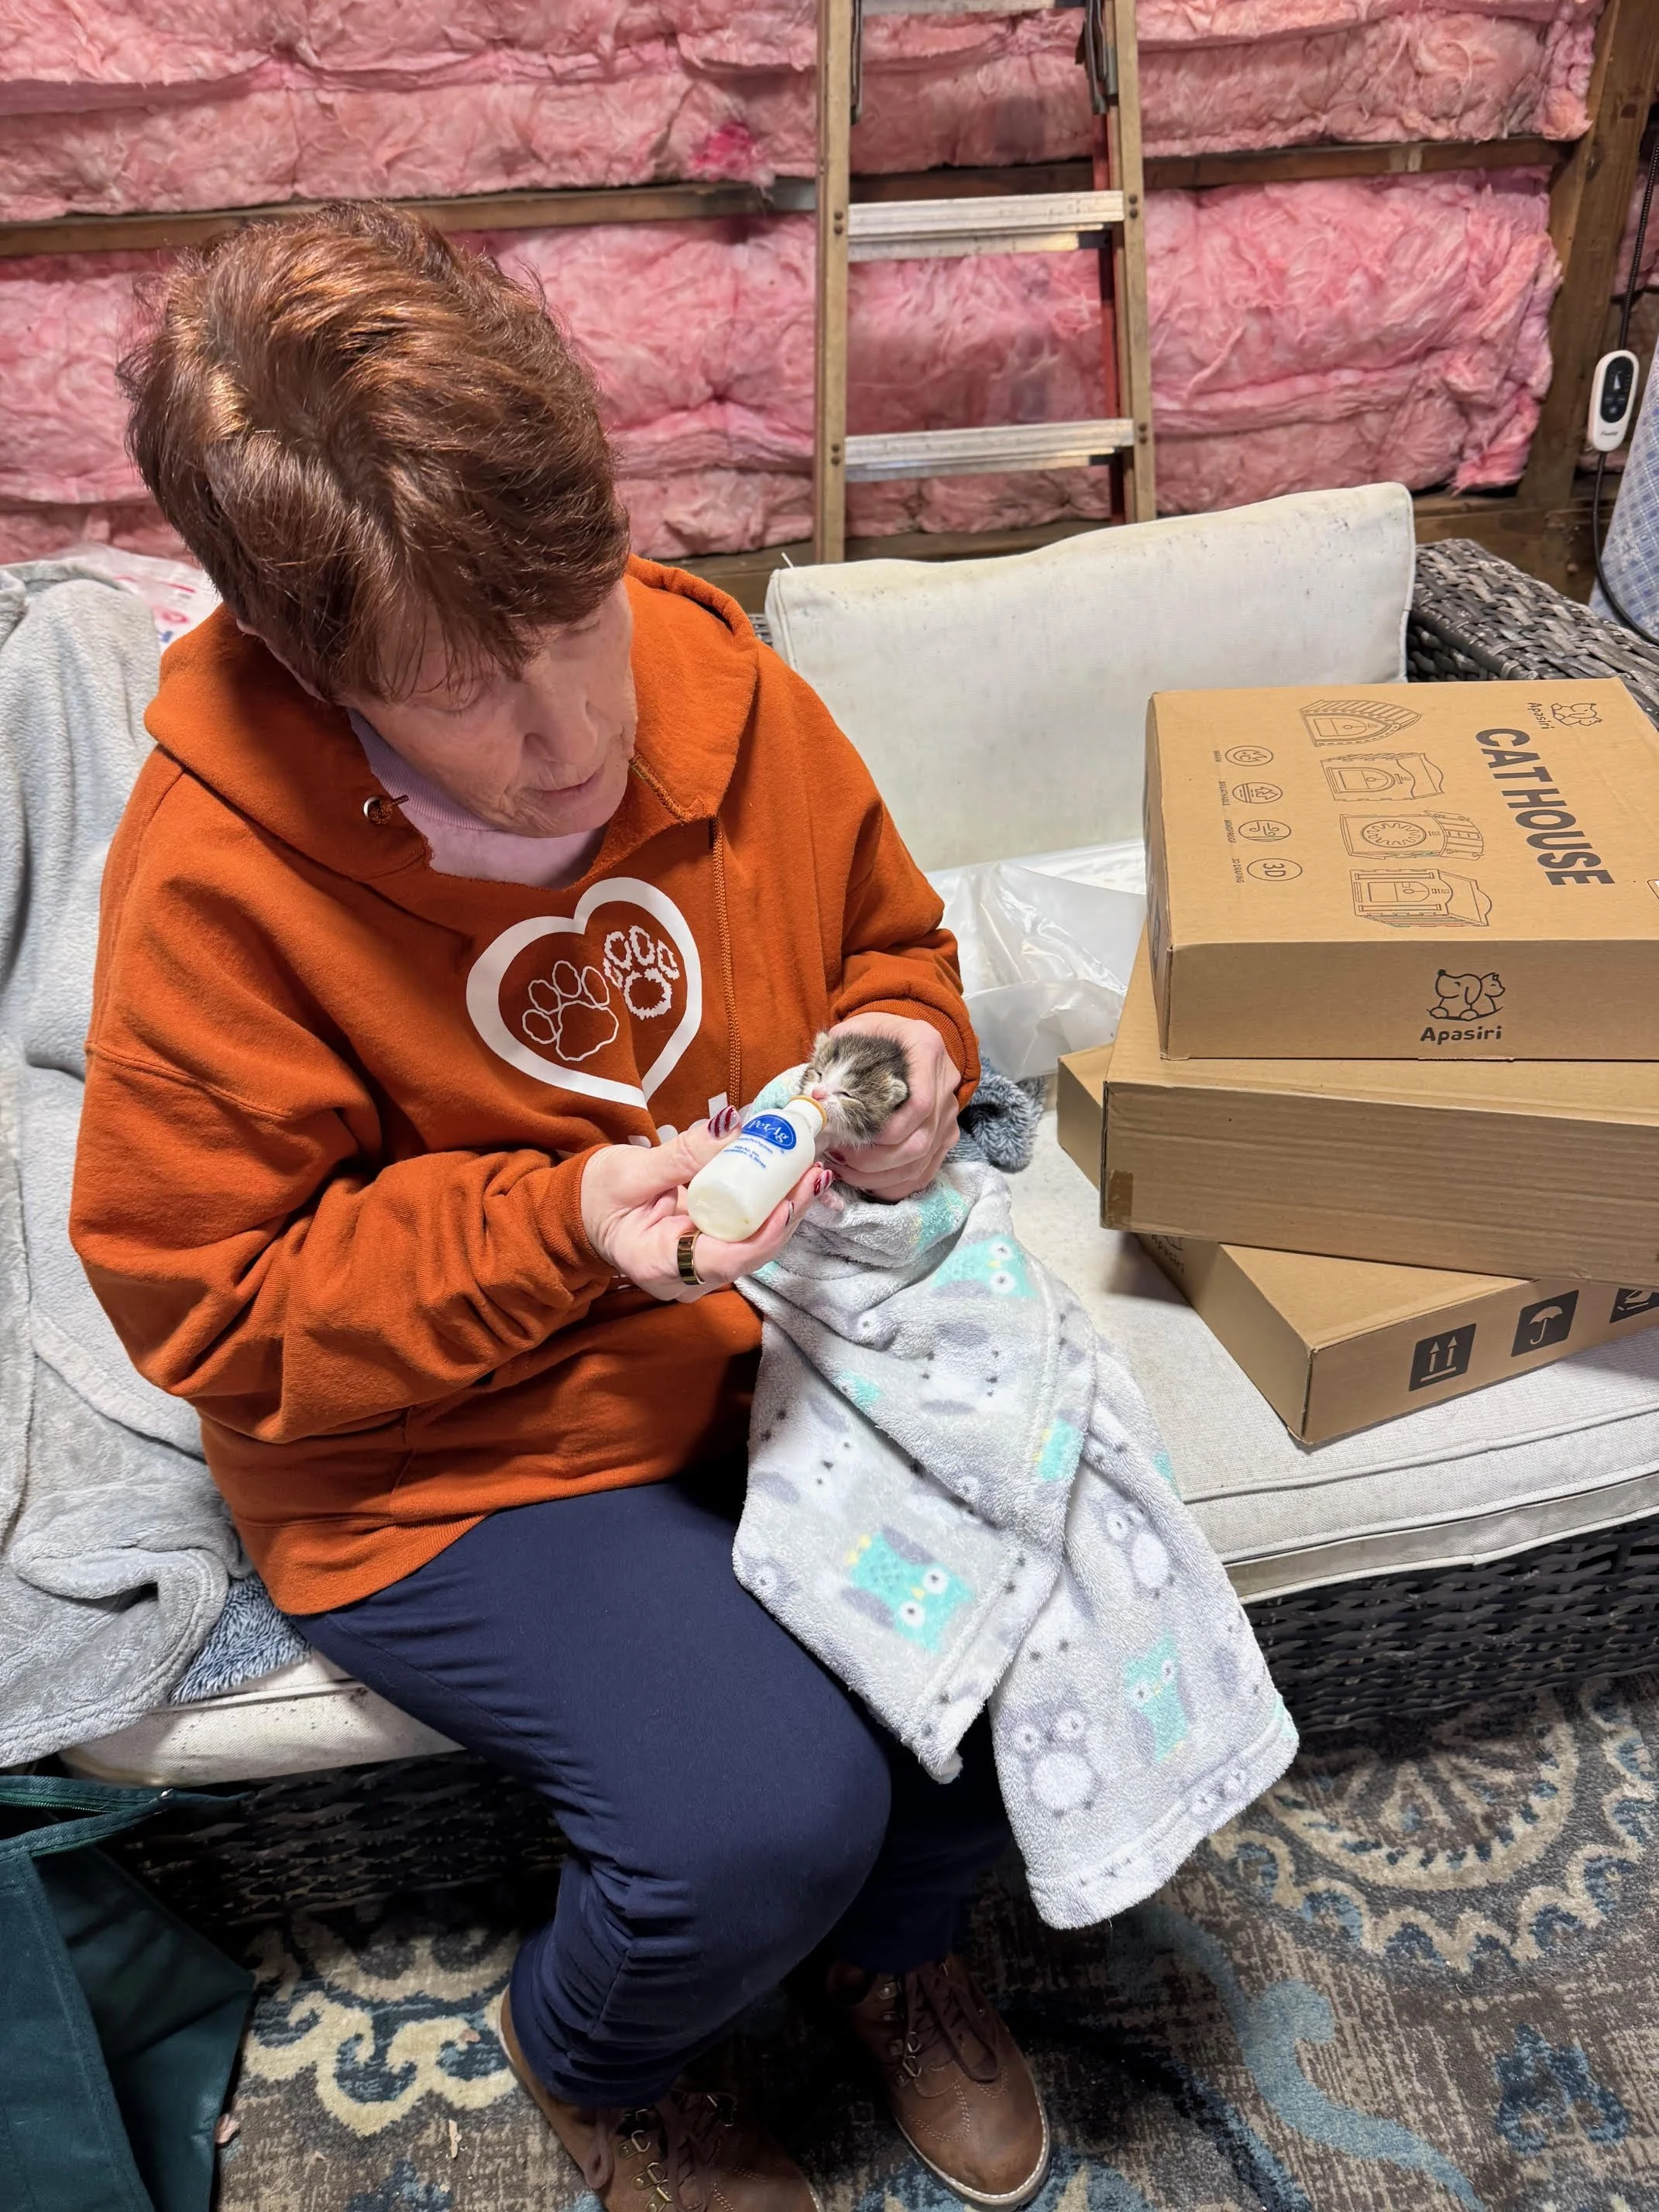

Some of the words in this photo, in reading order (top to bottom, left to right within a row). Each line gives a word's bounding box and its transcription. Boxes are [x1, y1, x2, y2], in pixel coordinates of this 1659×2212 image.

[1527, 702, 1555, 729] Apasiri
[1475, 727, 1553, 782] CAT
[1501, 788, 1615, 885] HOUSE
[1262, 863, 1286, 878] 3D
[1420, 1025, 1502, 1046] Apasiri
